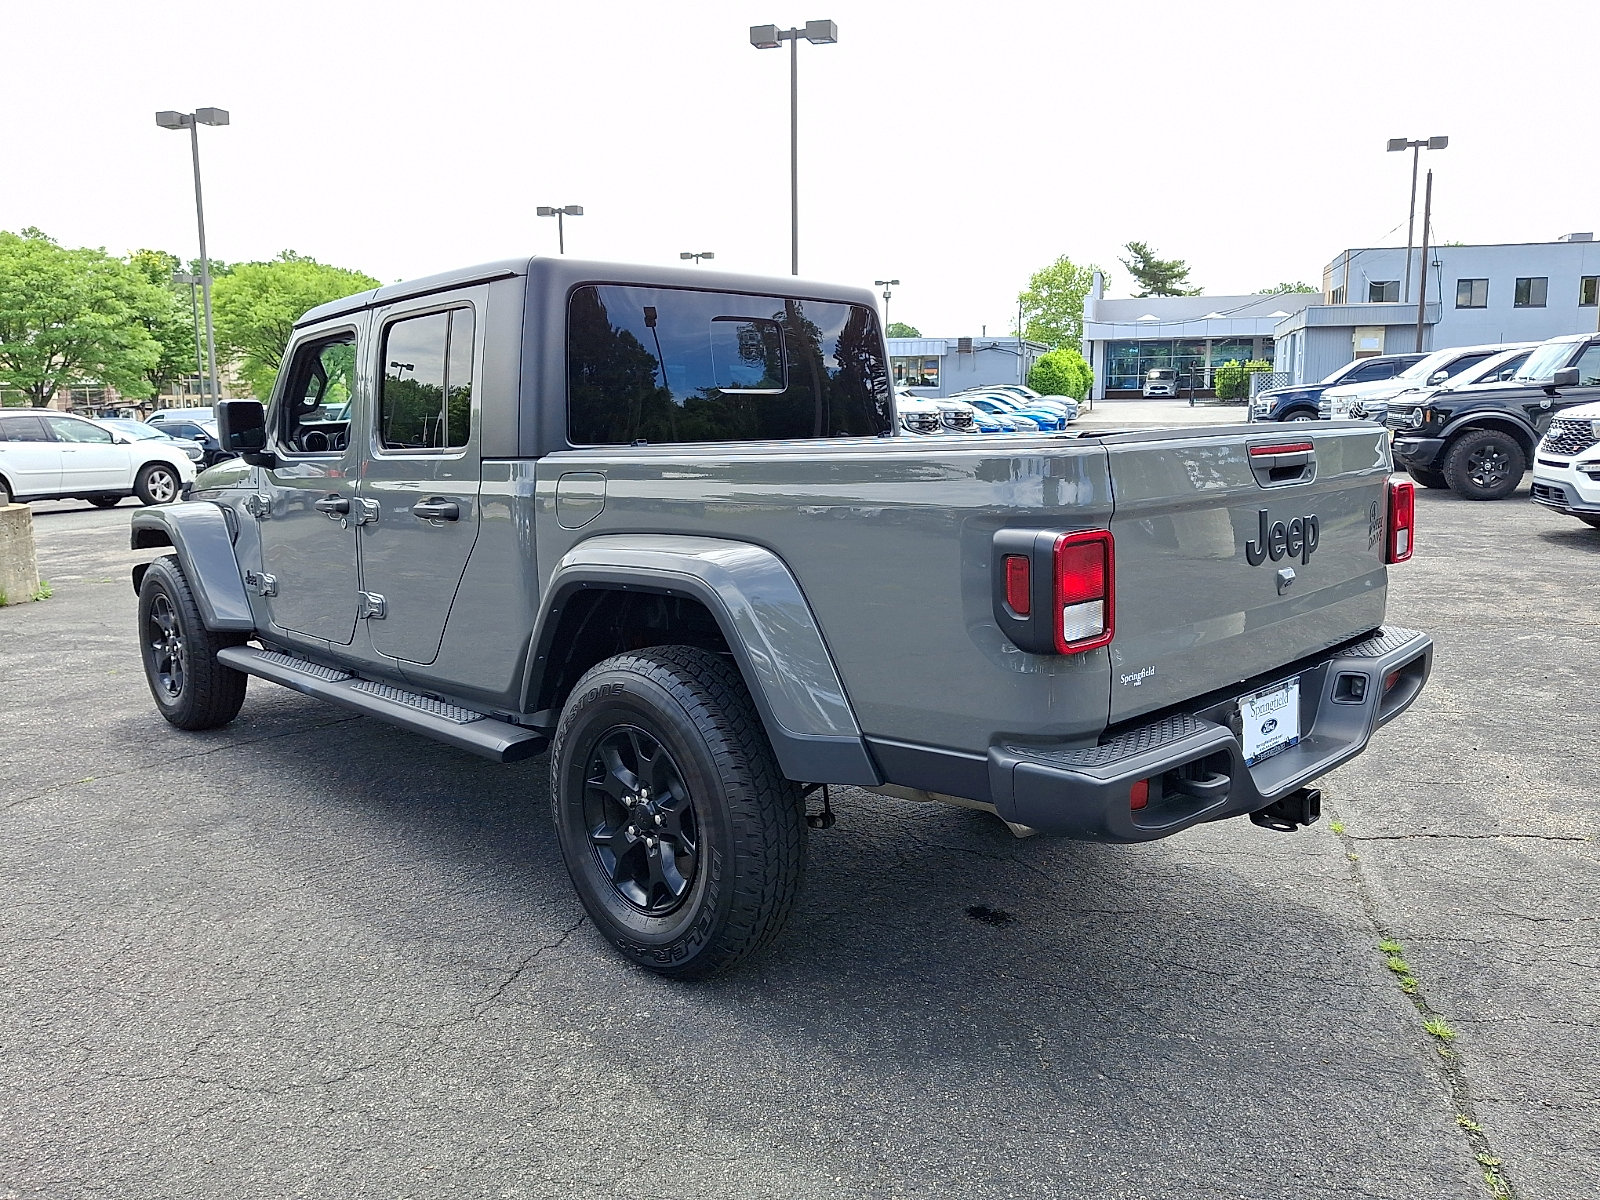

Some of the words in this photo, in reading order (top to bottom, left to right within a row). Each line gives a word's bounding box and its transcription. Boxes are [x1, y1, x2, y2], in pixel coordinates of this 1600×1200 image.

[1246, 507, 1320, 567] Jeep
[1120, 665, 1155, 686] Springfield
[1250, 688, 1289, 720] Springfield
